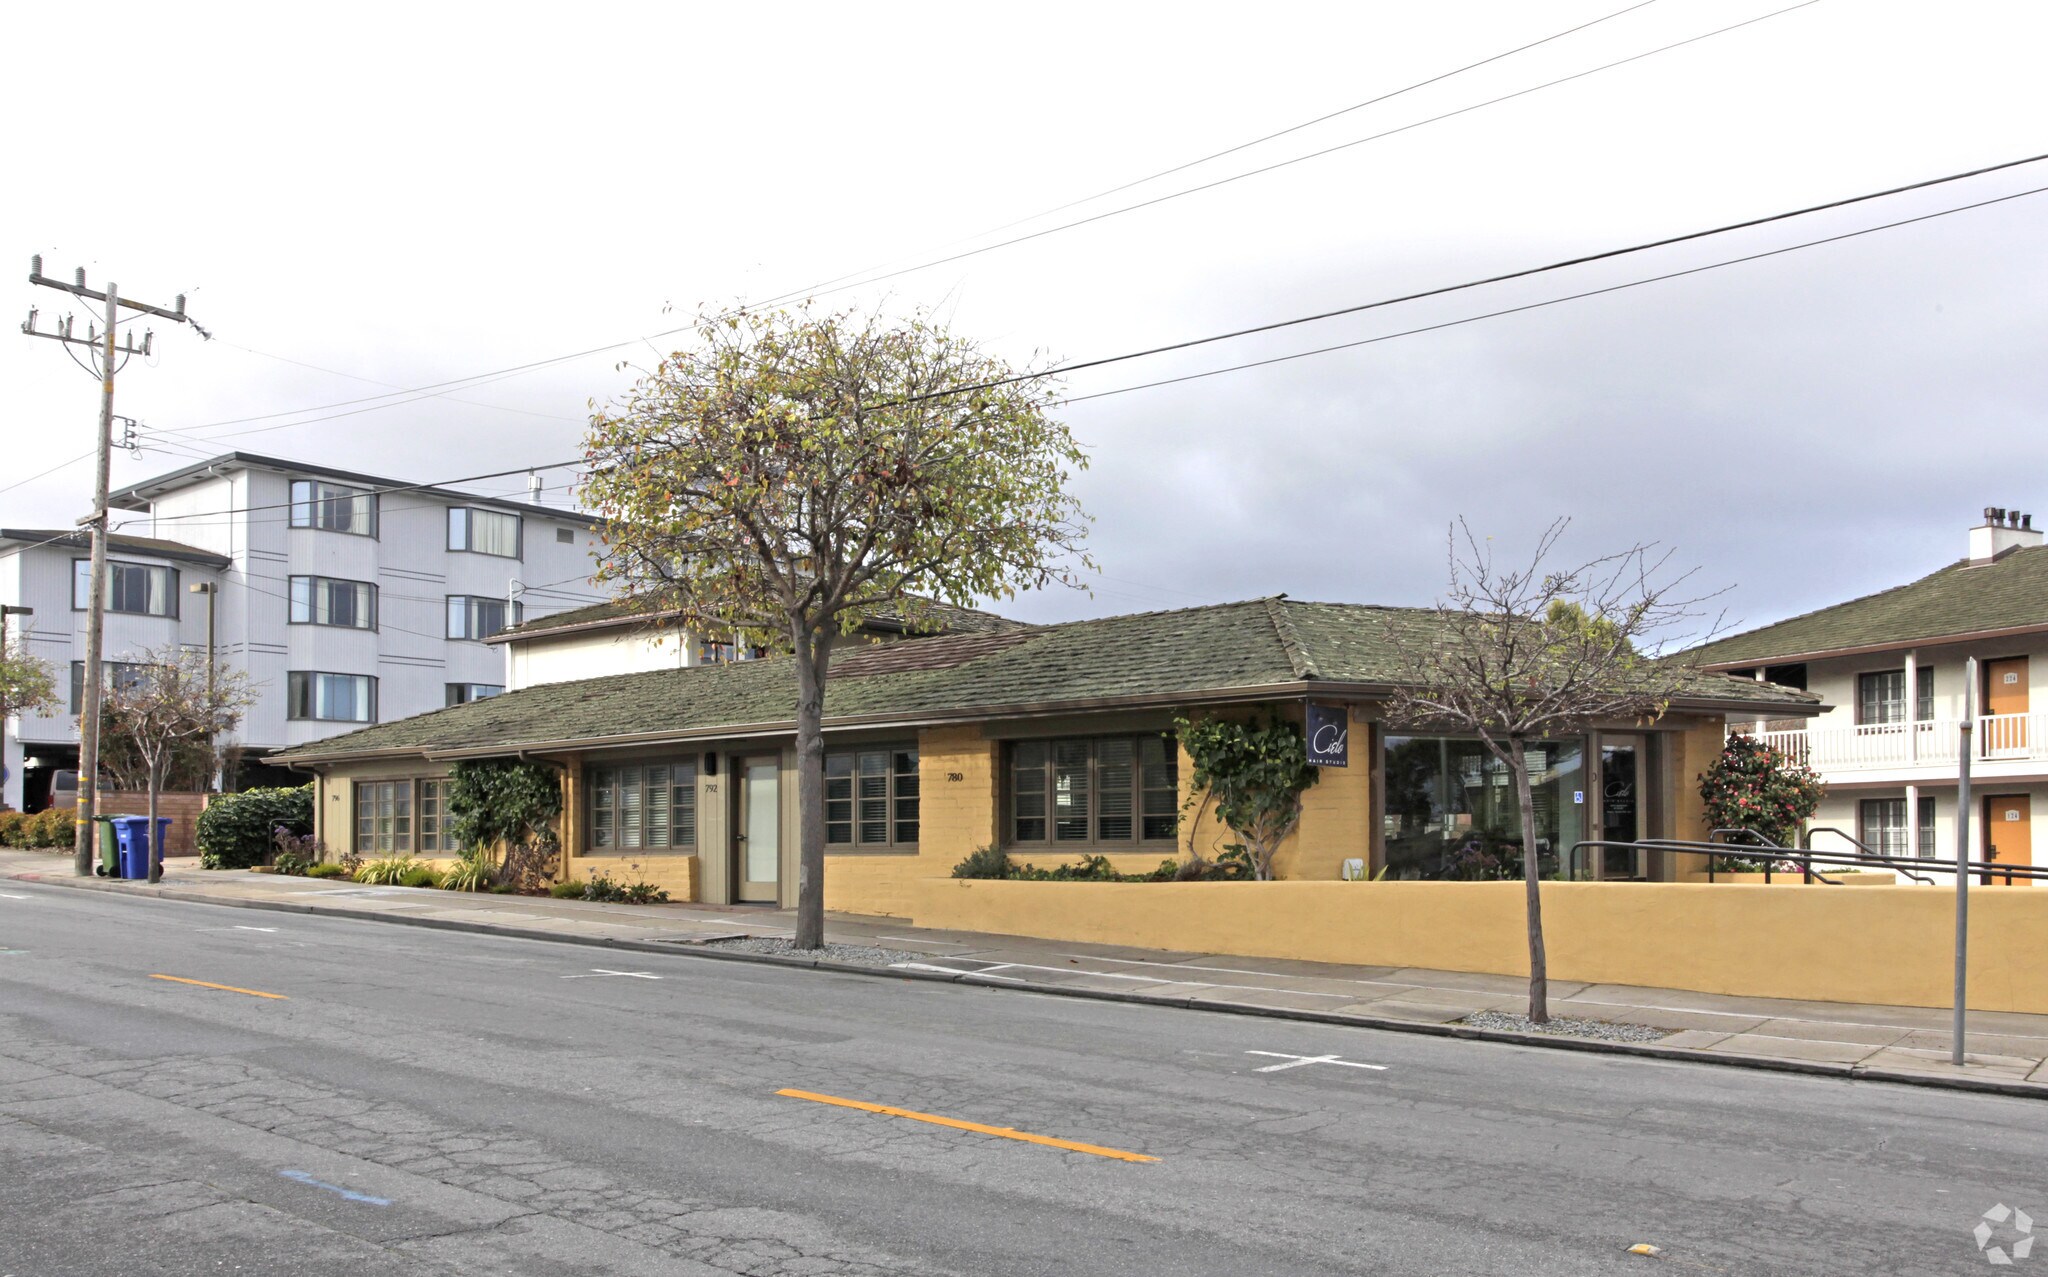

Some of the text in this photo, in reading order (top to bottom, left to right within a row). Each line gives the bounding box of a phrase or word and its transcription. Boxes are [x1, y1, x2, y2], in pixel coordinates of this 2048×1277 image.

[1313, 724, 1347, 755] Cielo
[947, 772, 963, 782] 780
[705, 784, 718, 793] 792
